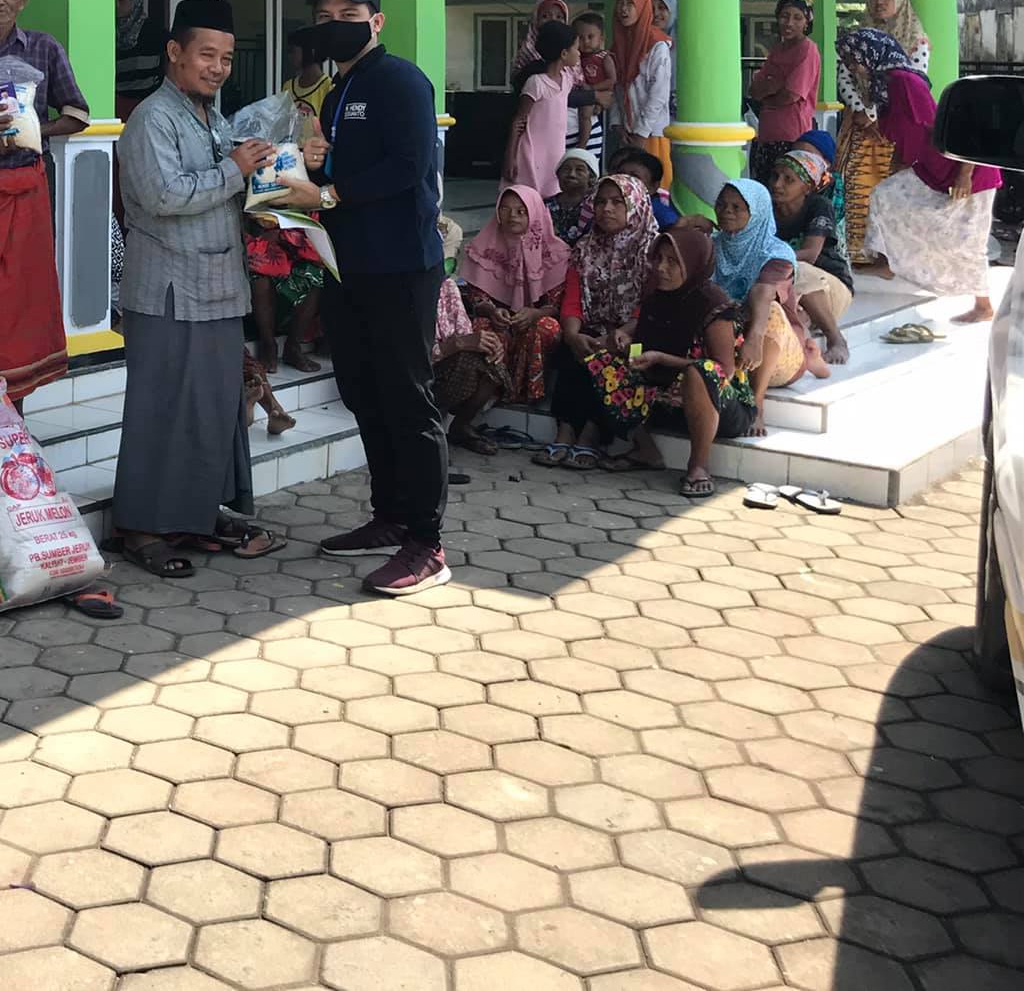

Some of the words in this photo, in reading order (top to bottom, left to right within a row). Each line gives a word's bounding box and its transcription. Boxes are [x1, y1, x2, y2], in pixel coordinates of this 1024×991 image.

[15, 508, 46, 527] JERUK
[45, 505, 73, 520] MELON
[33, 532, 57, 545] BERAT
[58, 530, 68, 540] 25
